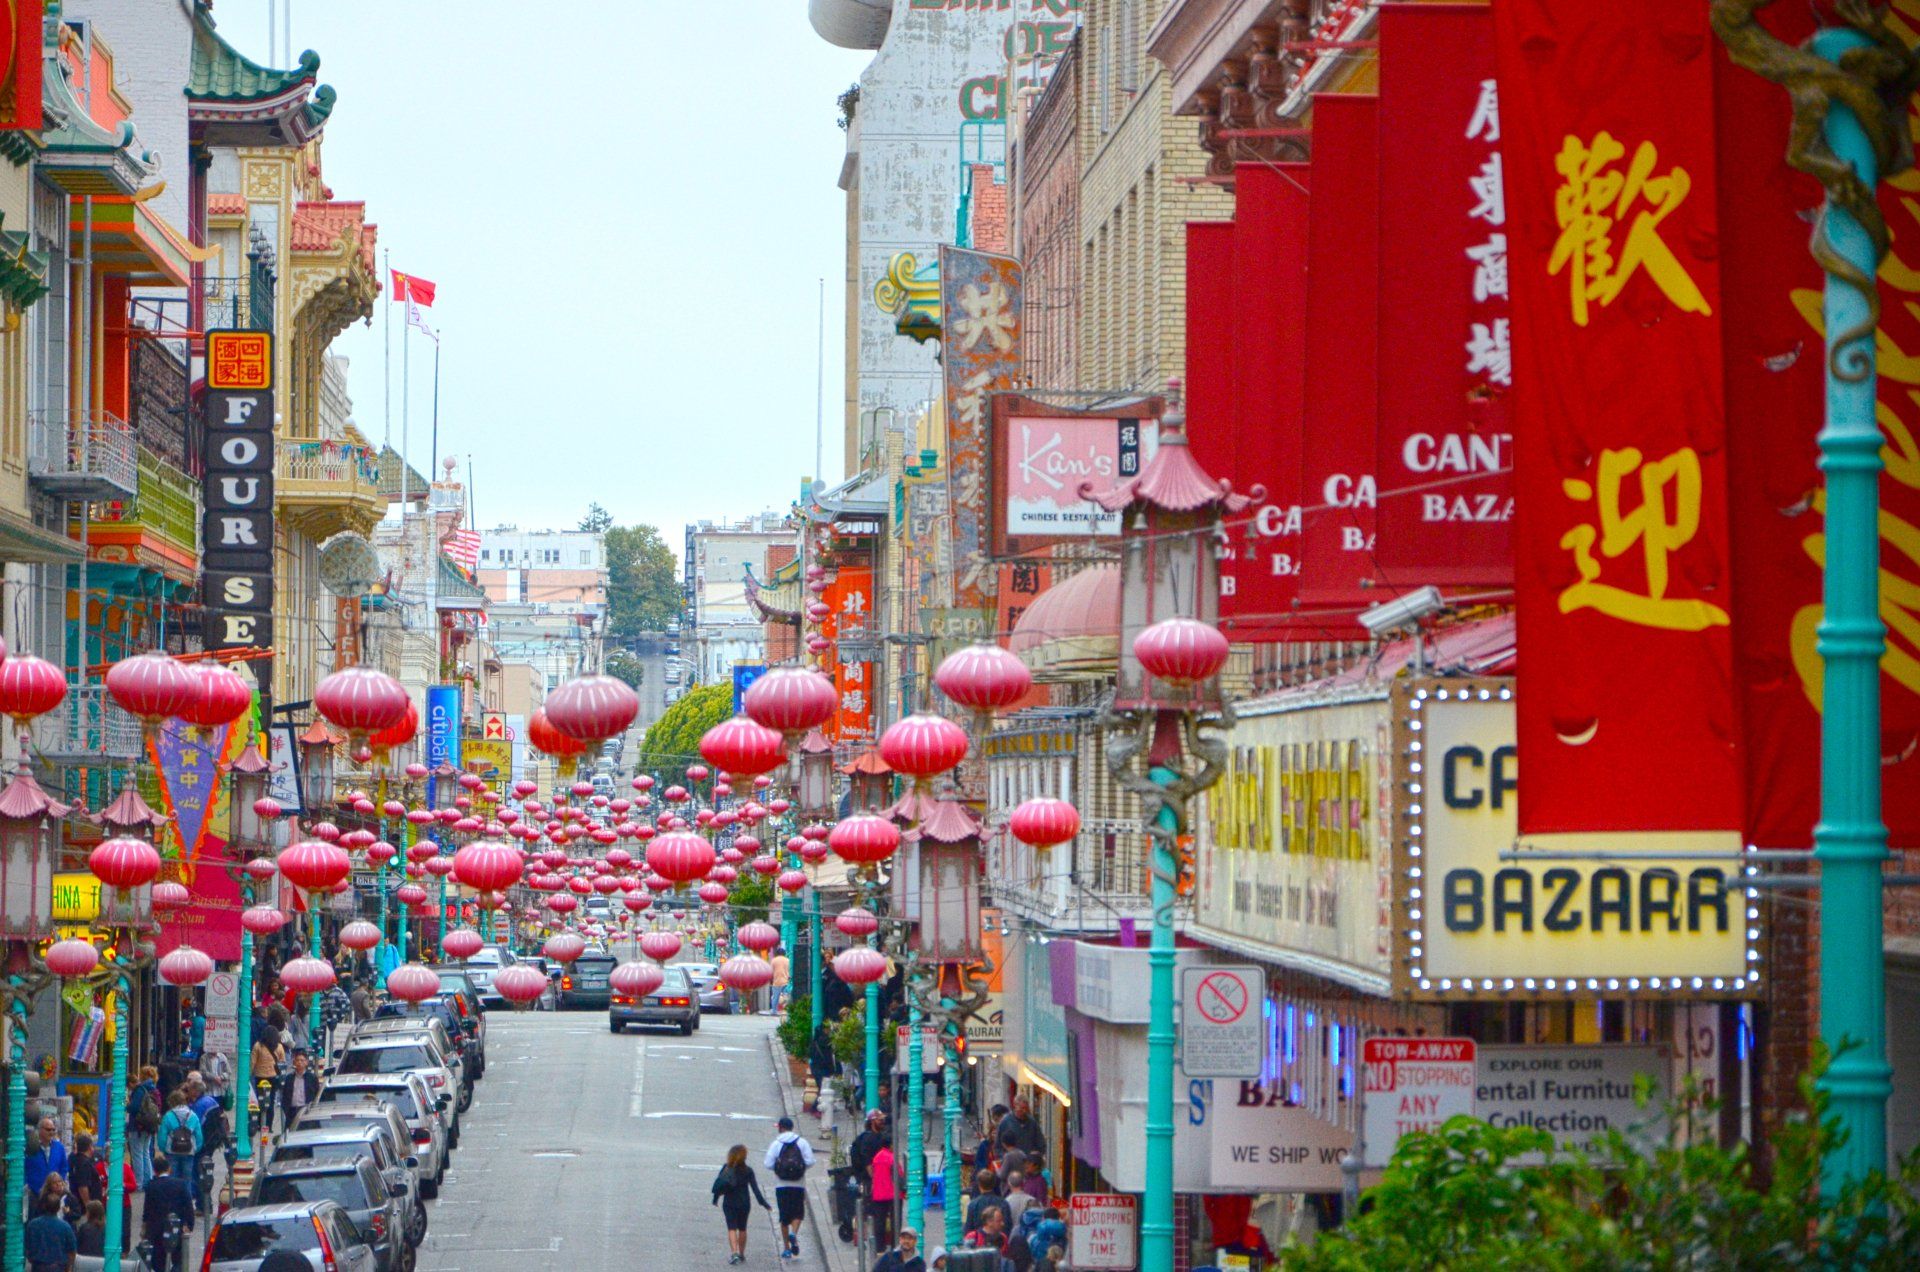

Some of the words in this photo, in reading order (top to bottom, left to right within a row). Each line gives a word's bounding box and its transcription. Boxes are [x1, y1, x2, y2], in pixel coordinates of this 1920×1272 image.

[1547, 131, 1730, 628] 歡迎
[1018, 424, 1113, 490] Kan's
[221, 397, 259, 545] FOUR
[1022, 512, 1058, 521] CHINESE
[1442, 745, 1518, 810] CA
[1443, 867, 1730, 933] BAZAAR
[1374, 1042, 1465, 1059] TOW-AWAY
[1489, 1059, 1562, 1072] EXPLORE
[1567, 1059, 1603, 1071] OUR
[1365, 1061, 1393, 1091] NO
[1397, 1067, 1472, 1086] STOPPING
[1399, 1095, 1440, 1115] ANY
[1232, 1147, 1260, 1163] WE
[1269, 1147, 1310, 1164] SHIP
[1074, 1197, 1132, 1208] TOW-AWAY
[1073, 1209, 1089, 1224] NO
[1091, 1212, 1132, 1225] STOPPING
[1091, 1229, 1116, 1241] ANY
[1089, 1243, 1117, 1256] TIME
